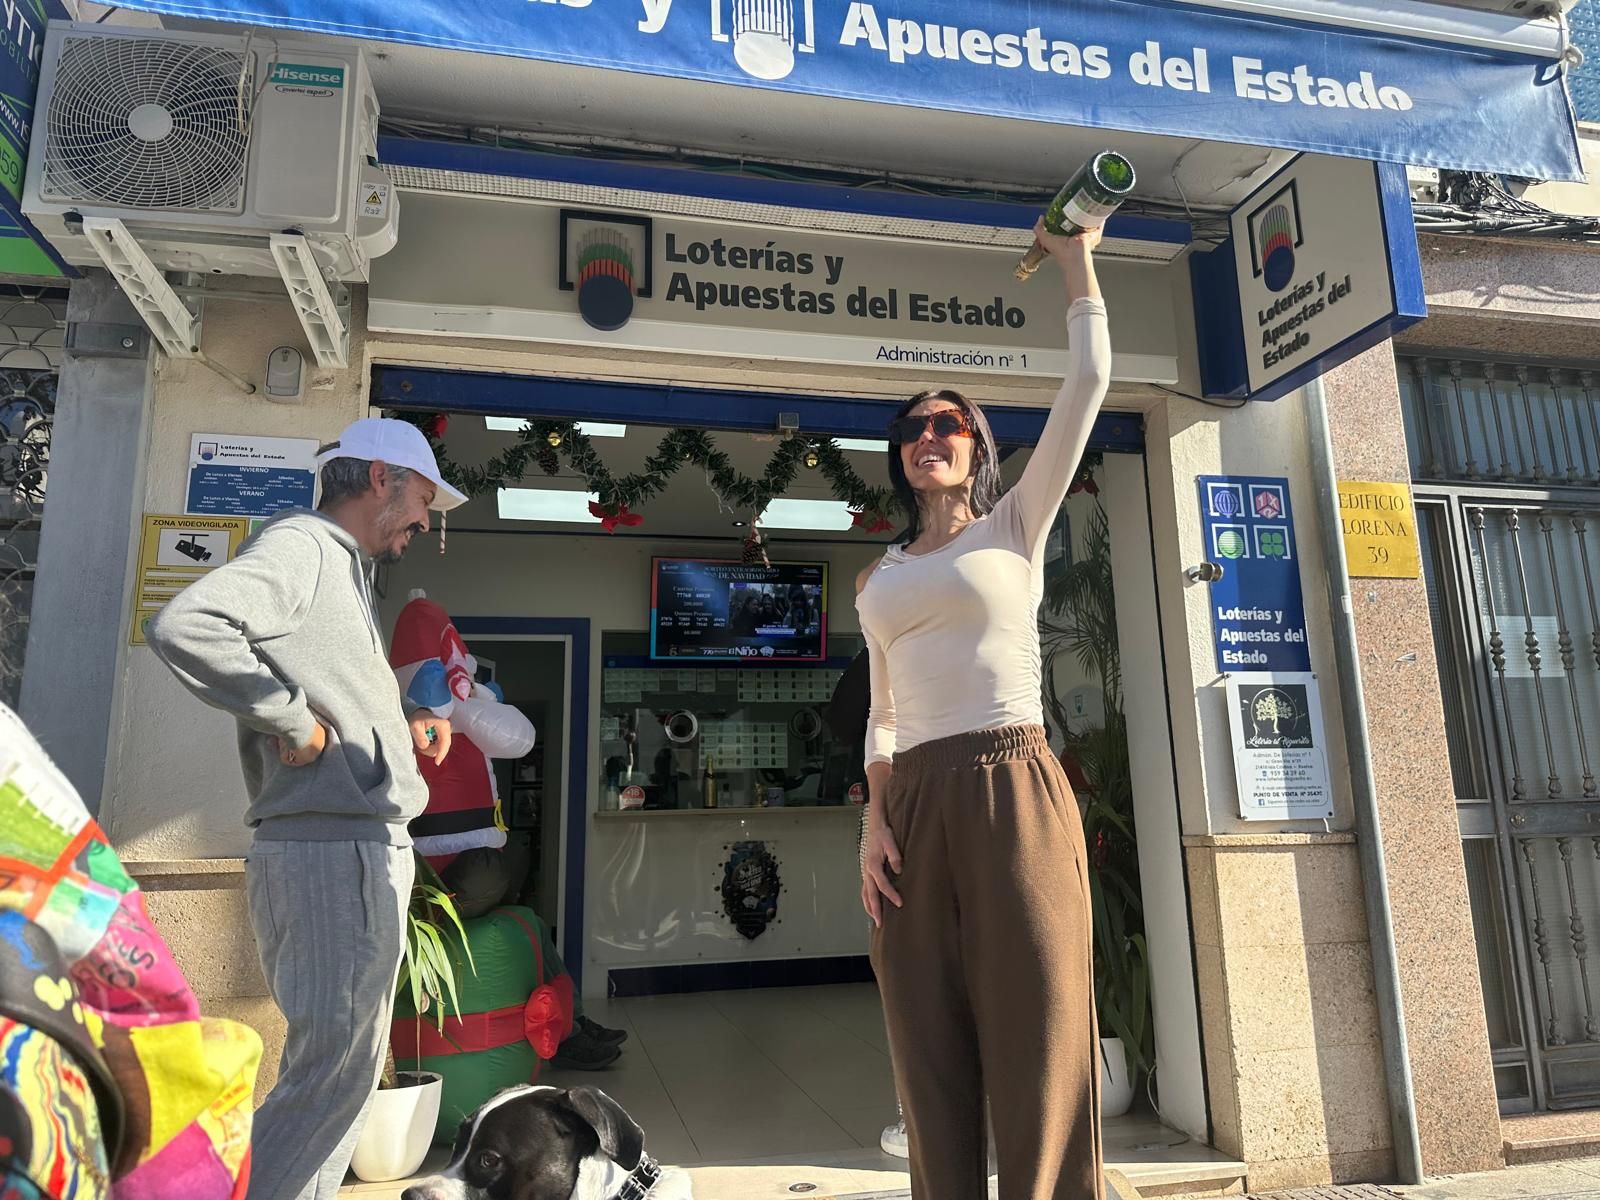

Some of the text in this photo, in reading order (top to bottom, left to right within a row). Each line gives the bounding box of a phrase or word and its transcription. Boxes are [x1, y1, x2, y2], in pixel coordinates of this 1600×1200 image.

[839, 2, 1414, 111] Apuestas del Estado
[271, 68, 341, 84] Hisense
[665, 232, 844, 285] Loterías y
[1316, 271, 1326, 292] y
[665, 272, 1026, 328] Apuestas del Estado
[1262, 274, 1352, 348] Apuestas del
[876, 345, 994, 367] Administración
[1021, 354, 1027, 368] 1
[1262, 331, 1311, 370] Estado
[1338, 493, 1404, 511] EDIFICIO
[153, 519, 239, 529] ZONA VIDEOVIGILADA
[1341, 518, 1408, 537] LORENA
[1367, 546, 1389, 564] 39
[731, 572, 766, 580] NAVIDAD
[1217, 606, 1283, 624] Loterías y
[1220, 628, 1304, 645] Apuestas del
[1222, 649, 1268, 664] Estado
